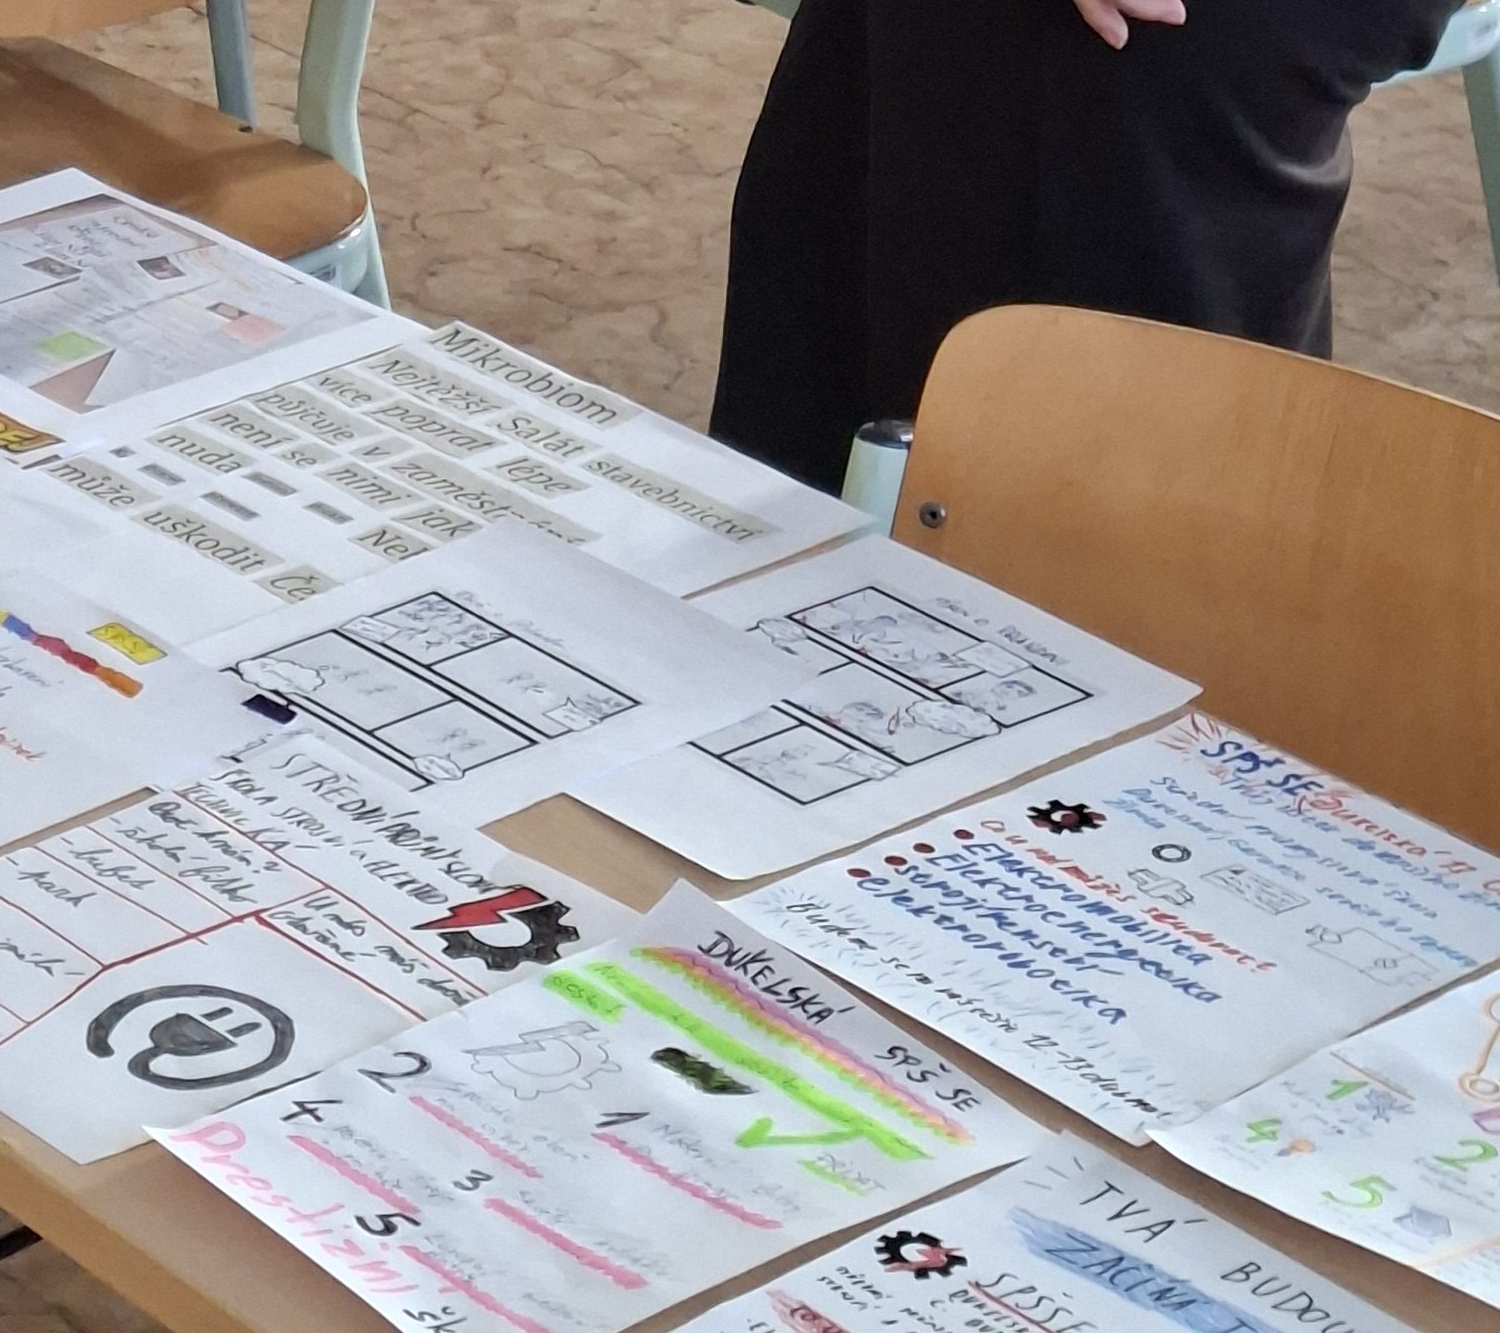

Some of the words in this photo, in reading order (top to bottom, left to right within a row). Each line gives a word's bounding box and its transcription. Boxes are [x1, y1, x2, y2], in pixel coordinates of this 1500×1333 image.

[430, 328, 618, 425] Mikrobiom
[155, 433, 243, 475] nuda
[254, 389, 357, 445] půjčuje
[361, 445, 391, 461] v
[319, 374, 374, 406] více
[367, 403, 496, 453] poprat
[496, 458, 574, 494] lépe
[368, 358, 502, 418] Nejtěžší
[497, 417, 589, 460] Salát
[587, 456, 764, 543] stavebnictví
[208, 410, 294, 450] není
[281, 447, 318, 469] se
[325, 468, 415, 507] nimi
[400, 508, 477, 539] jak
[47, 461, 137, 508] může
[143, 508, 268, 574] uškodit
[1200, 740, 1286, 774] SPŠ
[961, 841, 1214, 967] Elektromobilita
[697, 930, 855, 1026] DUKELSKÁ
[874, 1044, 951, 1084] SPŠ
[935, 1084, 982, 1113] SE
[357, 1049, 433, 1095] 2
[279, 1099, 344, 1124] 4
[452, 1169, 495, 1192] 3
[1432, 1138, 1498, 1171] 2
[354, 1212, 422, 1237] 5
[1079, 1179, 1208, 1245] TVÁ
[1321, 1174, 1396, 1209] 5
